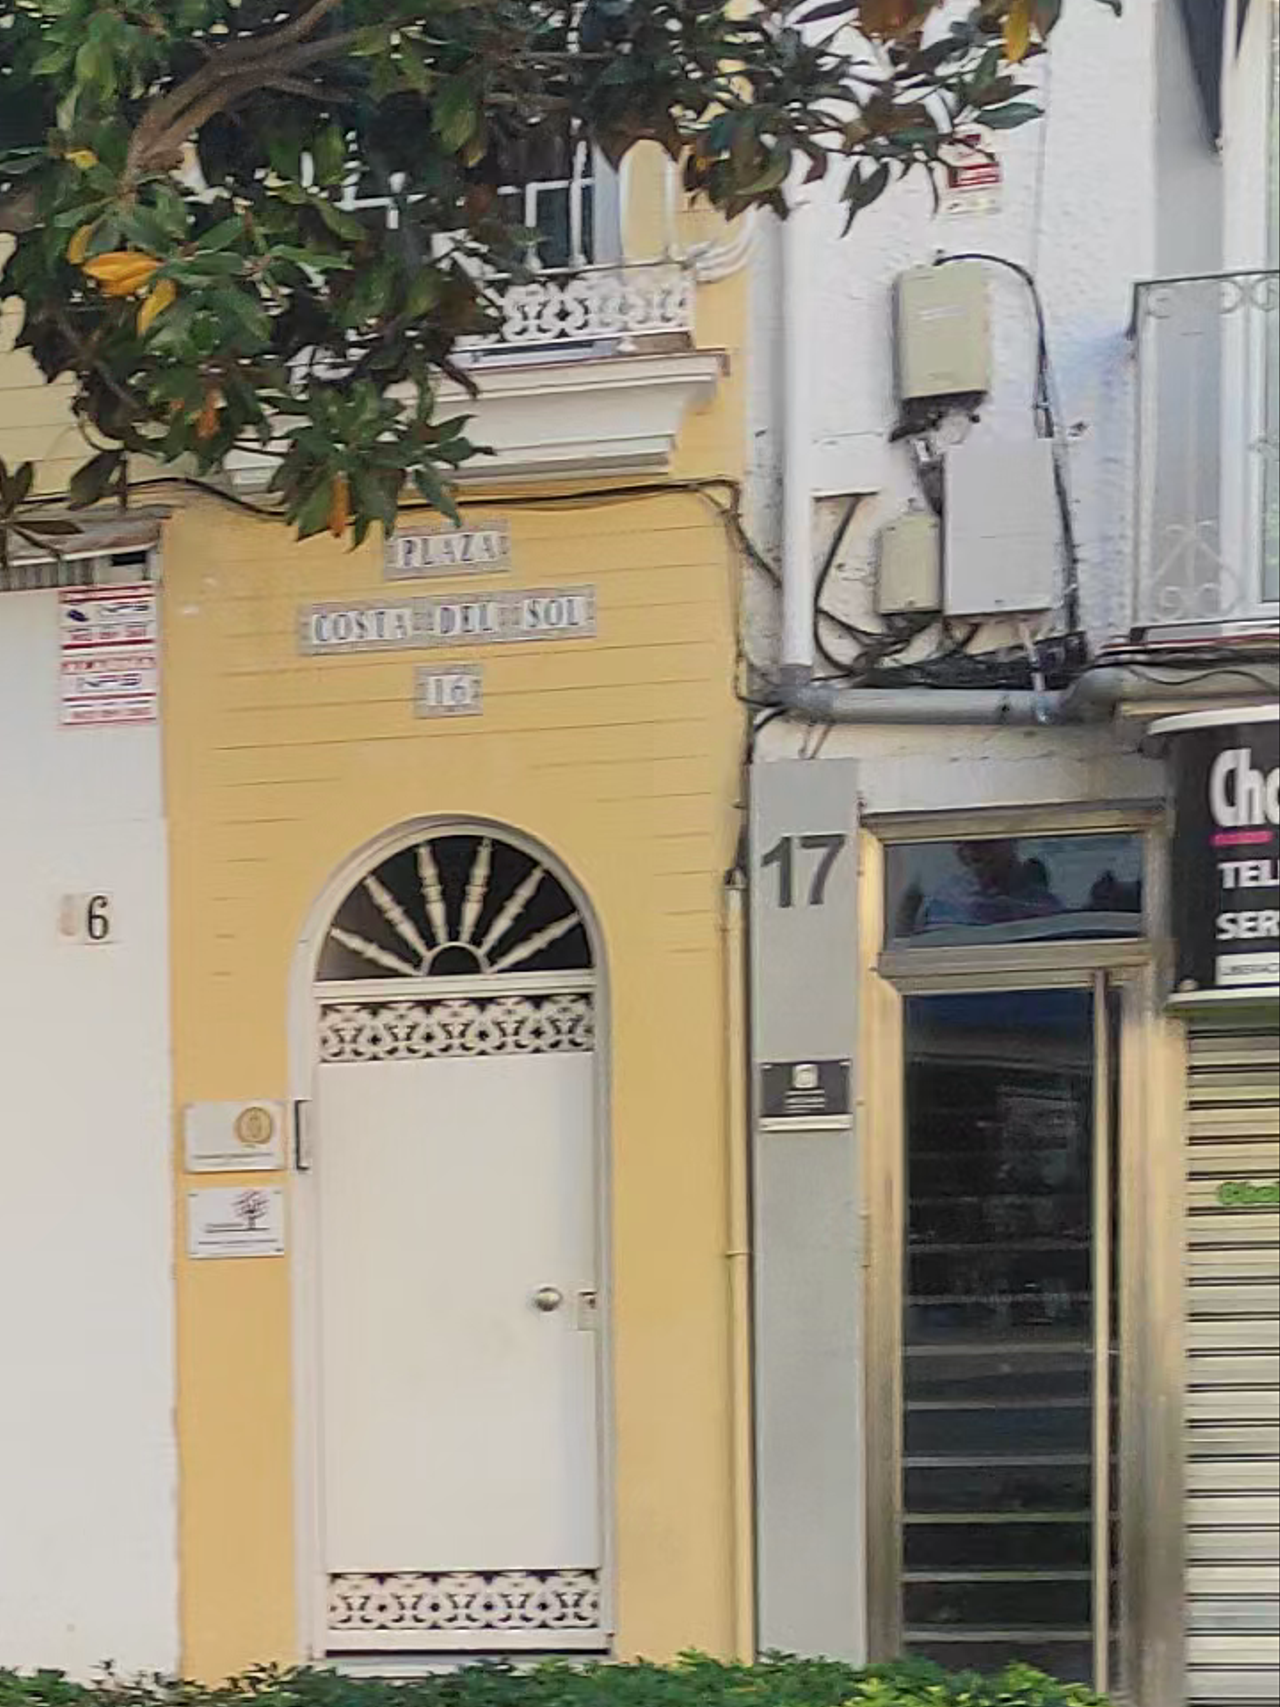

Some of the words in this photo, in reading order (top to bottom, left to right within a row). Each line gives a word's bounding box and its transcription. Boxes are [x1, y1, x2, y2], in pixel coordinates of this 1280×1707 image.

[402, 533, 499, 567] PLAZA
[315, 610, 408, 642] COSTA
[440, 604, 494, 635] DEL
[524, 597, 580, 628] SOL
[433, 676, 468, 705] 16
[760, 833, 847, 909] 17
[1217, 858, 1280, 890] TEL
